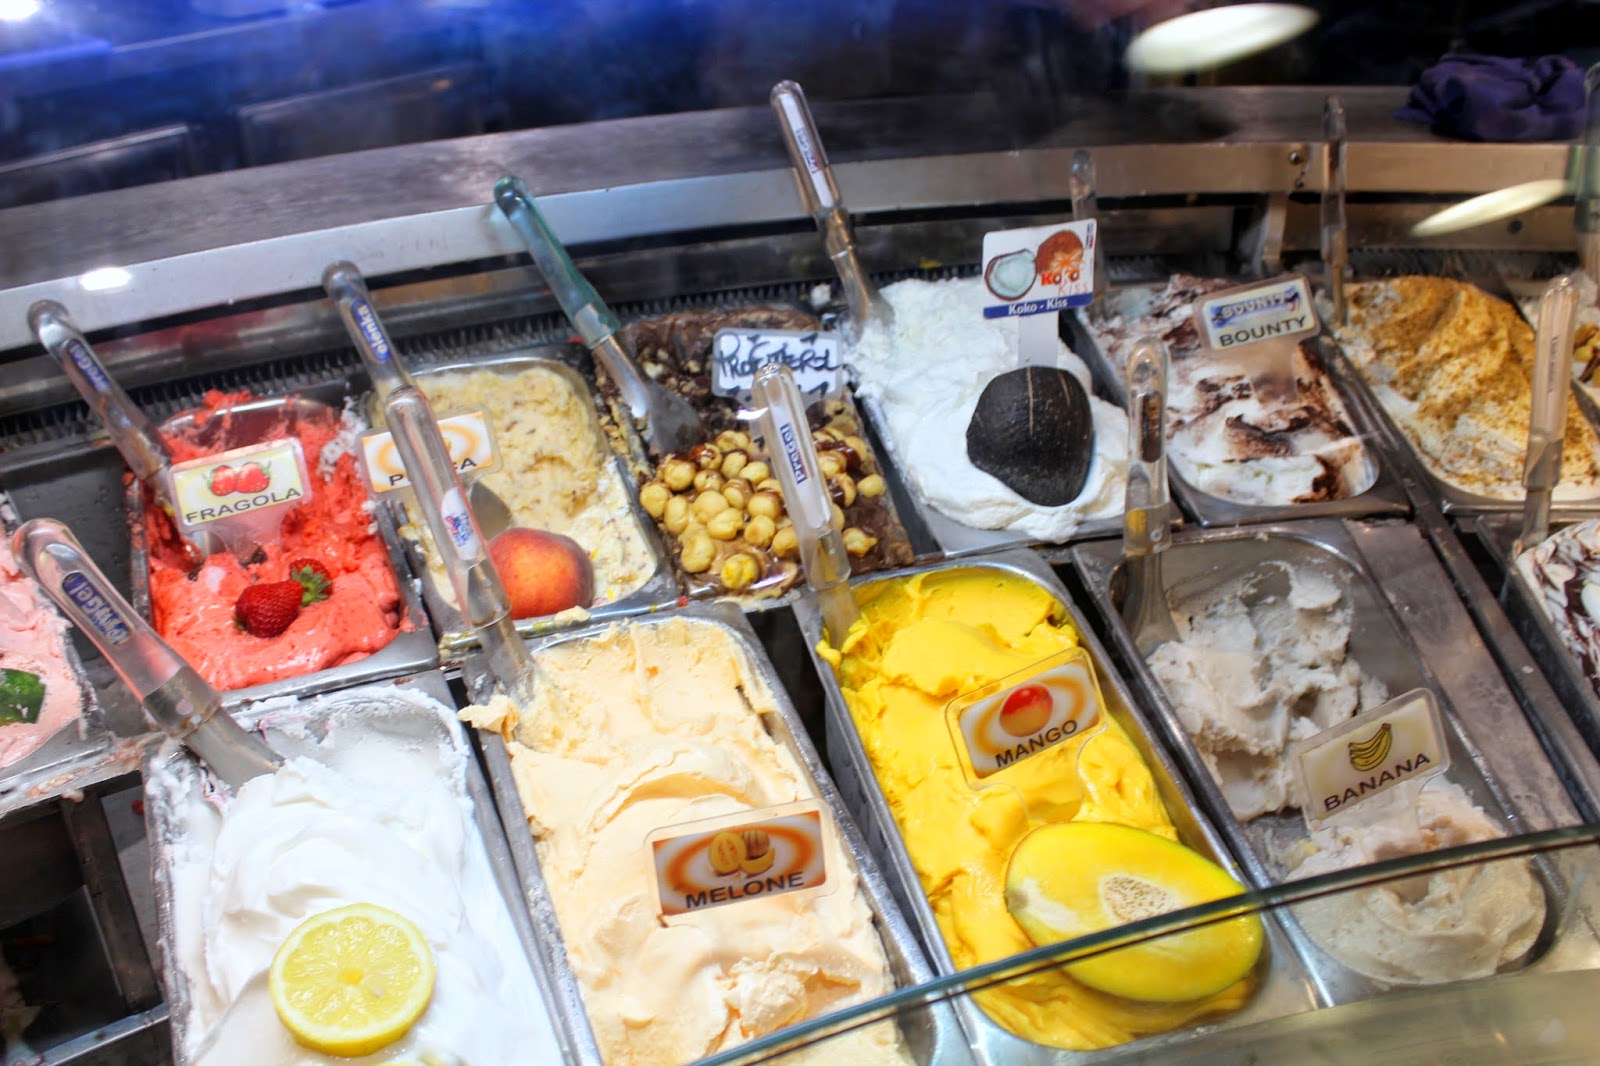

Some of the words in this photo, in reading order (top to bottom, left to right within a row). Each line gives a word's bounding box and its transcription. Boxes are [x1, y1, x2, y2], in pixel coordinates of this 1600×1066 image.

[1008, 301, 1038, 316] Koko
[1046, 297, 1068, 310] Kiss
[357, 304, 388, 354] elenka
[1219, 316, 1306, 347] BOUNTY
[185, 487, 301, 523] FRAGOLA
[994, 719, 1077, 767] MANGO
[1323, 752, 1431, 811] BANANA
[685, 871, 805, 909] MELONE
